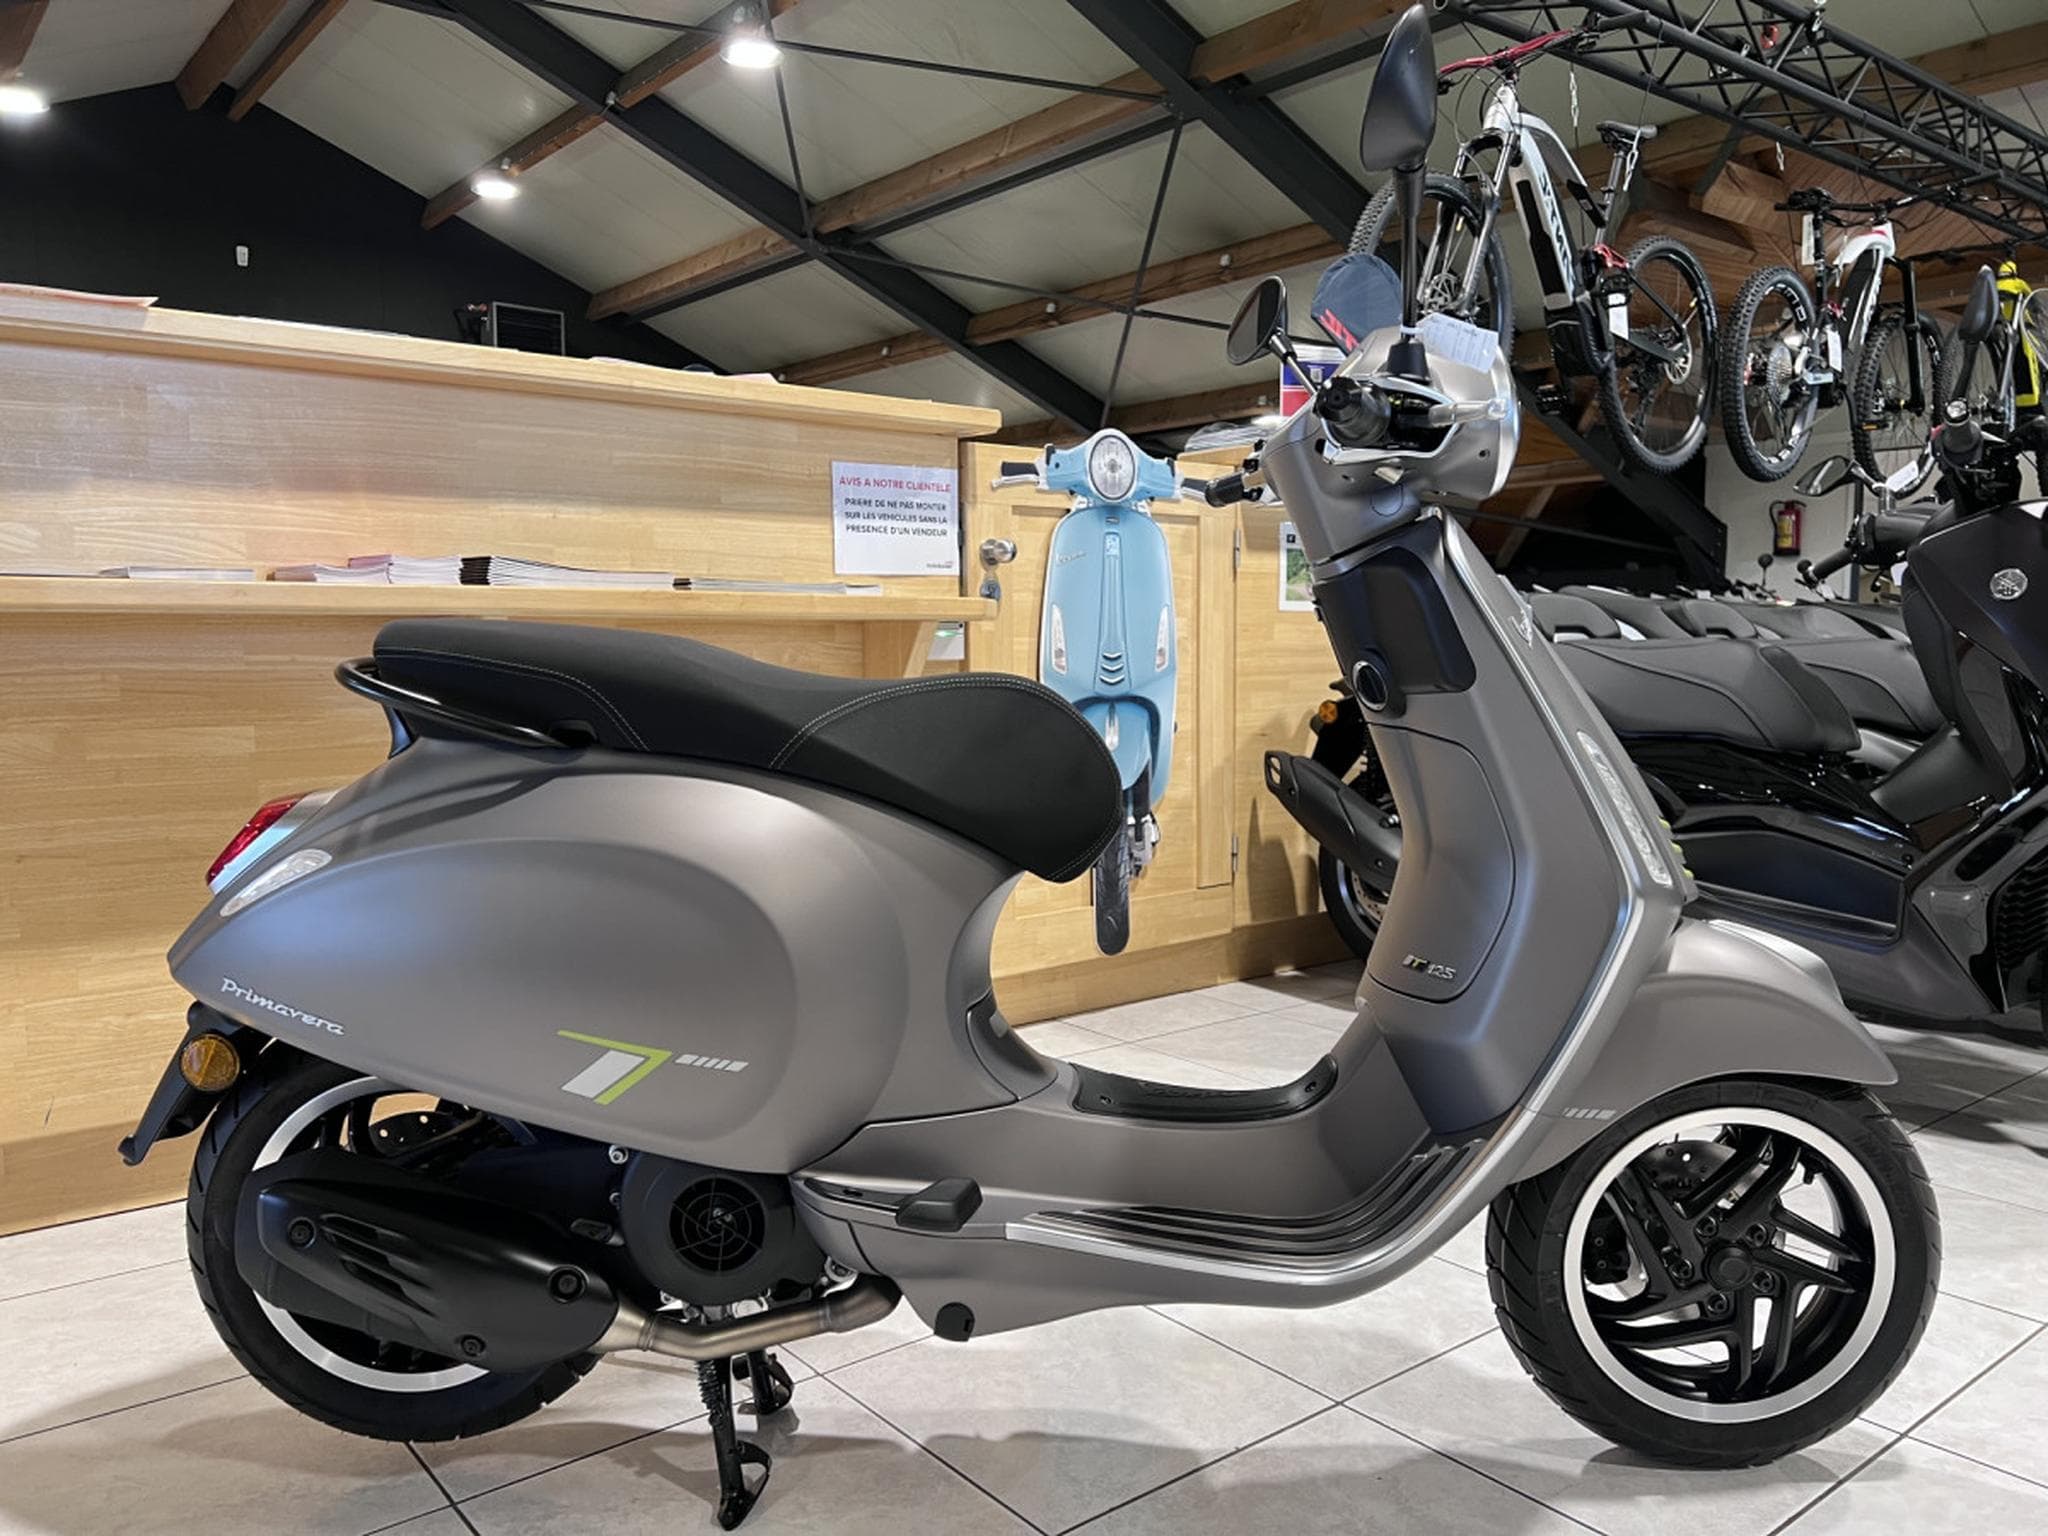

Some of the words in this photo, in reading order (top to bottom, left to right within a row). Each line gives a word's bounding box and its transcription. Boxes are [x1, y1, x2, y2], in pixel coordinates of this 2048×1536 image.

[839, 476, 862, 486] AVIS
[873, 478, 905, 489] NOTRE
[906, 481, 951, 493] CLIENTELE
[875, 499, 885, 508] DE
[887, 500, 898, 509] NE
[900, 501, 914, 510] PAS
[916, 502, 946, 511] MONTER
[844, 511, 861, 520] SUR
[862, 512, 876, 520] LES
[878, 513, 917, 522] VEHICULES
[919, 515, 938, 524] SANS
[939, 516, 948, 524] LA
[846, 524, 888, 535] PRESENCE
[890, 526, 910, 536] D'UN
[911, 528, 948, 537] VENDEUR
[221, 977, 345, 1035] Primavera
